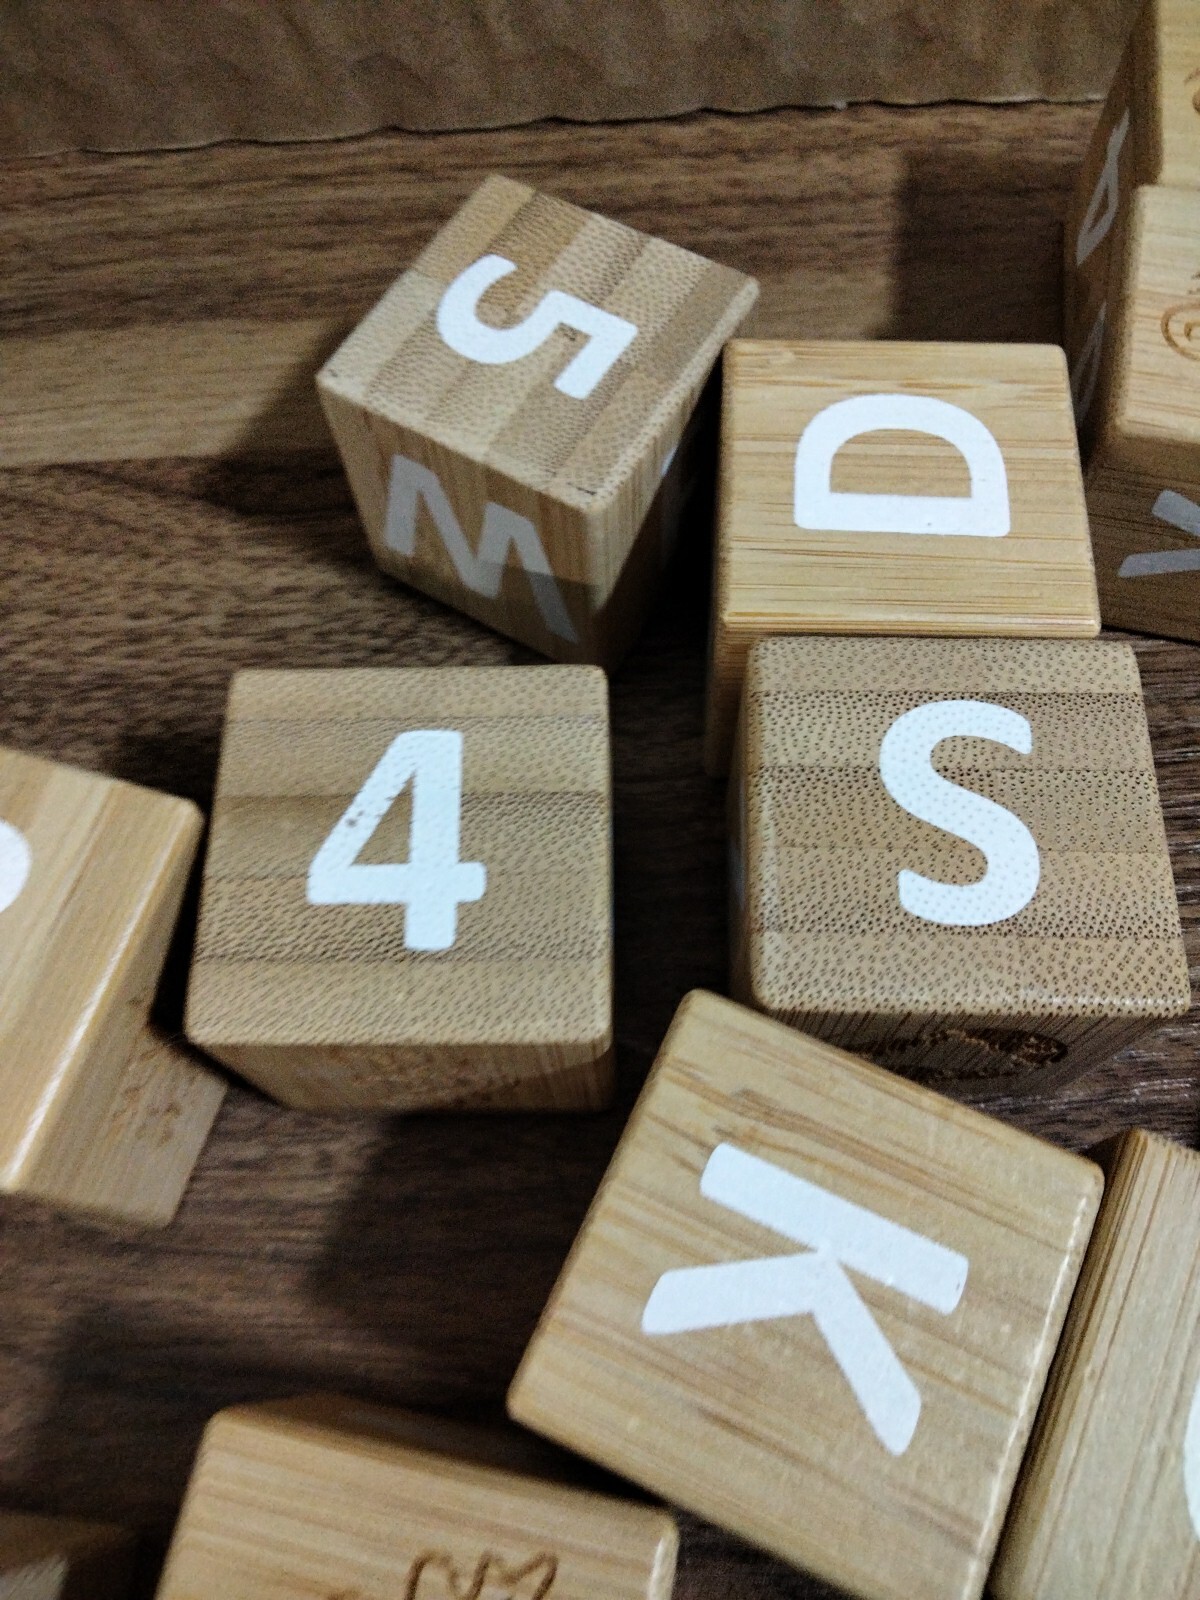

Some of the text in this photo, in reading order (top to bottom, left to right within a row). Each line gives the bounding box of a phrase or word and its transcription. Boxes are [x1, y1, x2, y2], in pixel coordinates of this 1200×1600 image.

[436, 253, 638, 399] 5
[794, 394, 1010, 537] D
[306, 729, 486, 952] 4
[879, 699, 1040, 926] S
[642, 1143, 969, 1455] K
